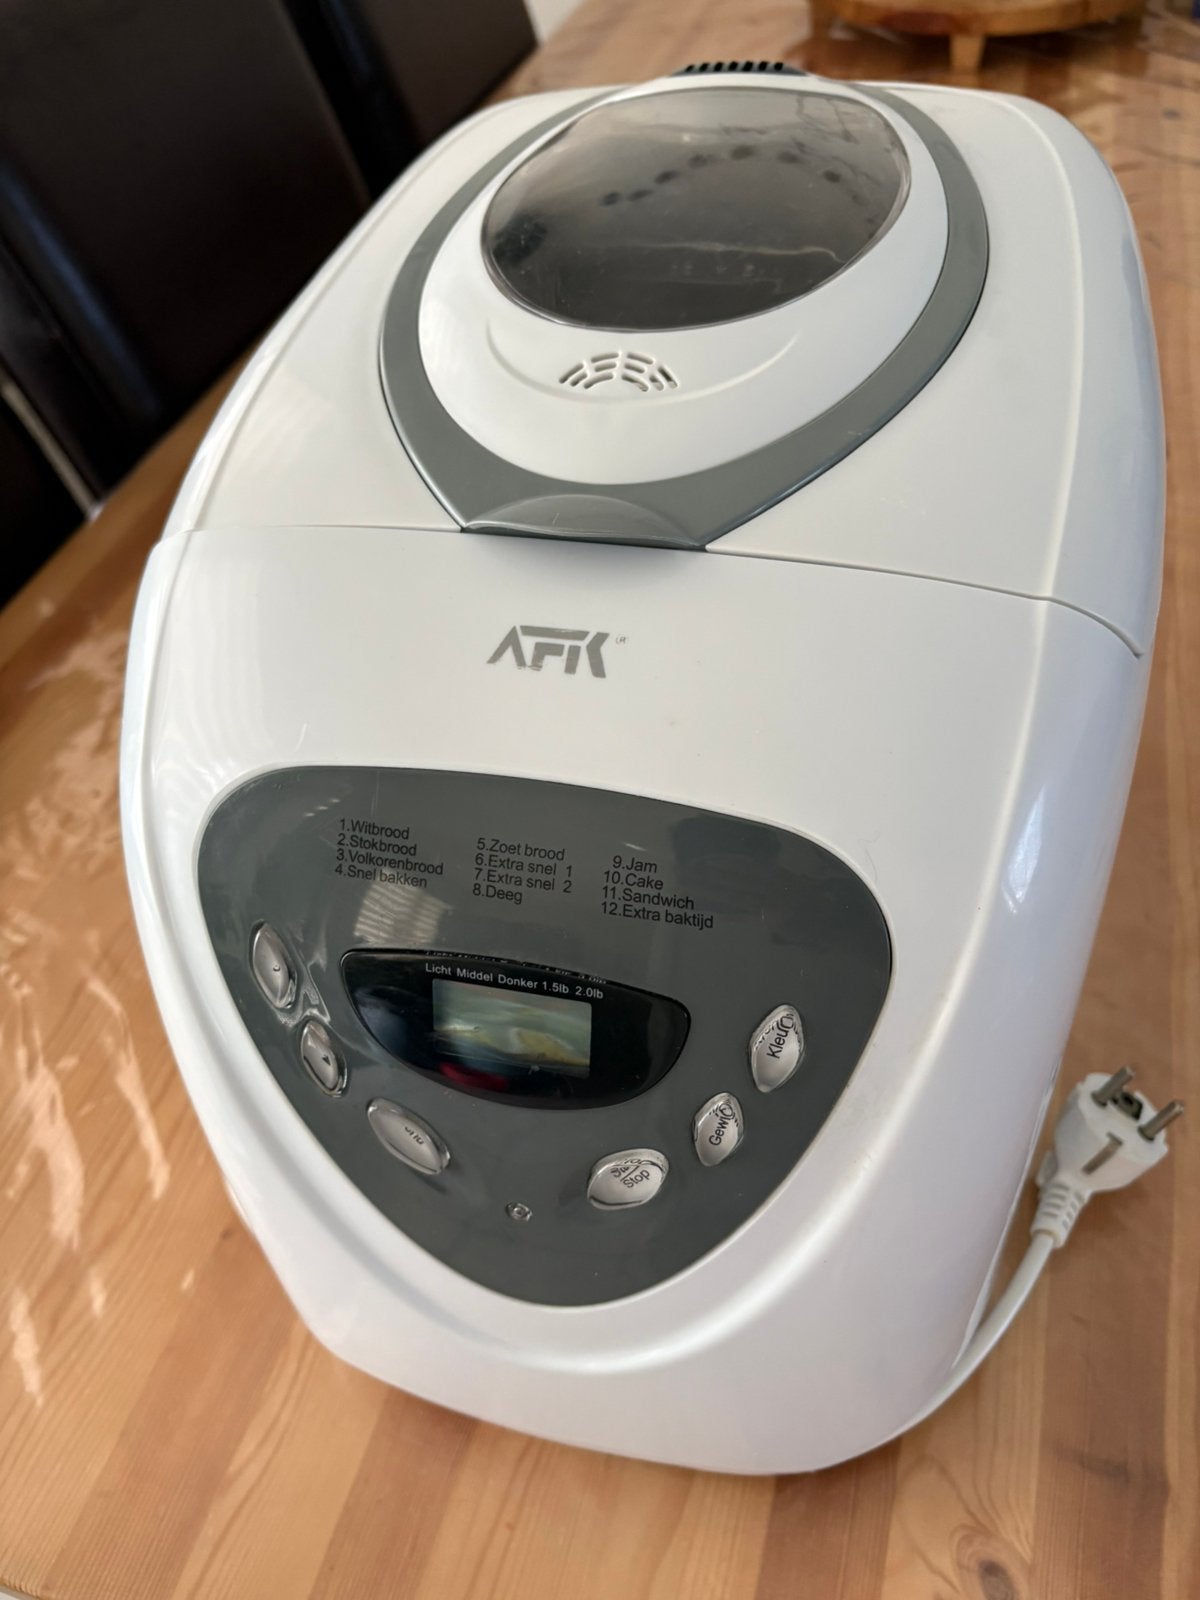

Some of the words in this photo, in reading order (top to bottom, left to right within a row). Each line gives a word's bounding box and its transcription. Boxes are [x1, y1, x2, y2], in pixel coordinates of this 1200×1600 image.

[339, 818, 410, 841] 1.Witbrood
[336, 832, 417, 857] 2.Stokbrood
[476, 837, 522, 856] 5.Zoet
[524, 844, 566, 861] brood
[335, 848, 444, 876] 3.Volkorenbrood
[474, 853, 525, 873] 6.Extra
[527, 859, 557, 876] snel
[565, 864, 573, 878] 1
[612, 855, 658, 874] 9.Jam
[334, 864, 377, 882] 4.Snel
[378, 869, 428, 888] bakken
[473, 868, 523, 887] 7.Extra
[526, 874, 556, 891] snel
[562, 879, 573, 894] 2
[603, 870, 664, 891] 10.Cake
[472, 883, 523, 905] 8.Deeg
[602, 885, 695, 911] 11.Sandwich
[601, 901, 662, 921] 12.Extra
[664, 908, 714, 931] baktijd
[425, 963, 453, 977] Licht
[456, 967, 494, 983] Middel
[498, 975, 539, 990] Donker
[542, 981, 570, 995] 1.5lb
[575, 985, 604, 1000] 2.0lb
[622, 1169, 651, 1189] Stop
